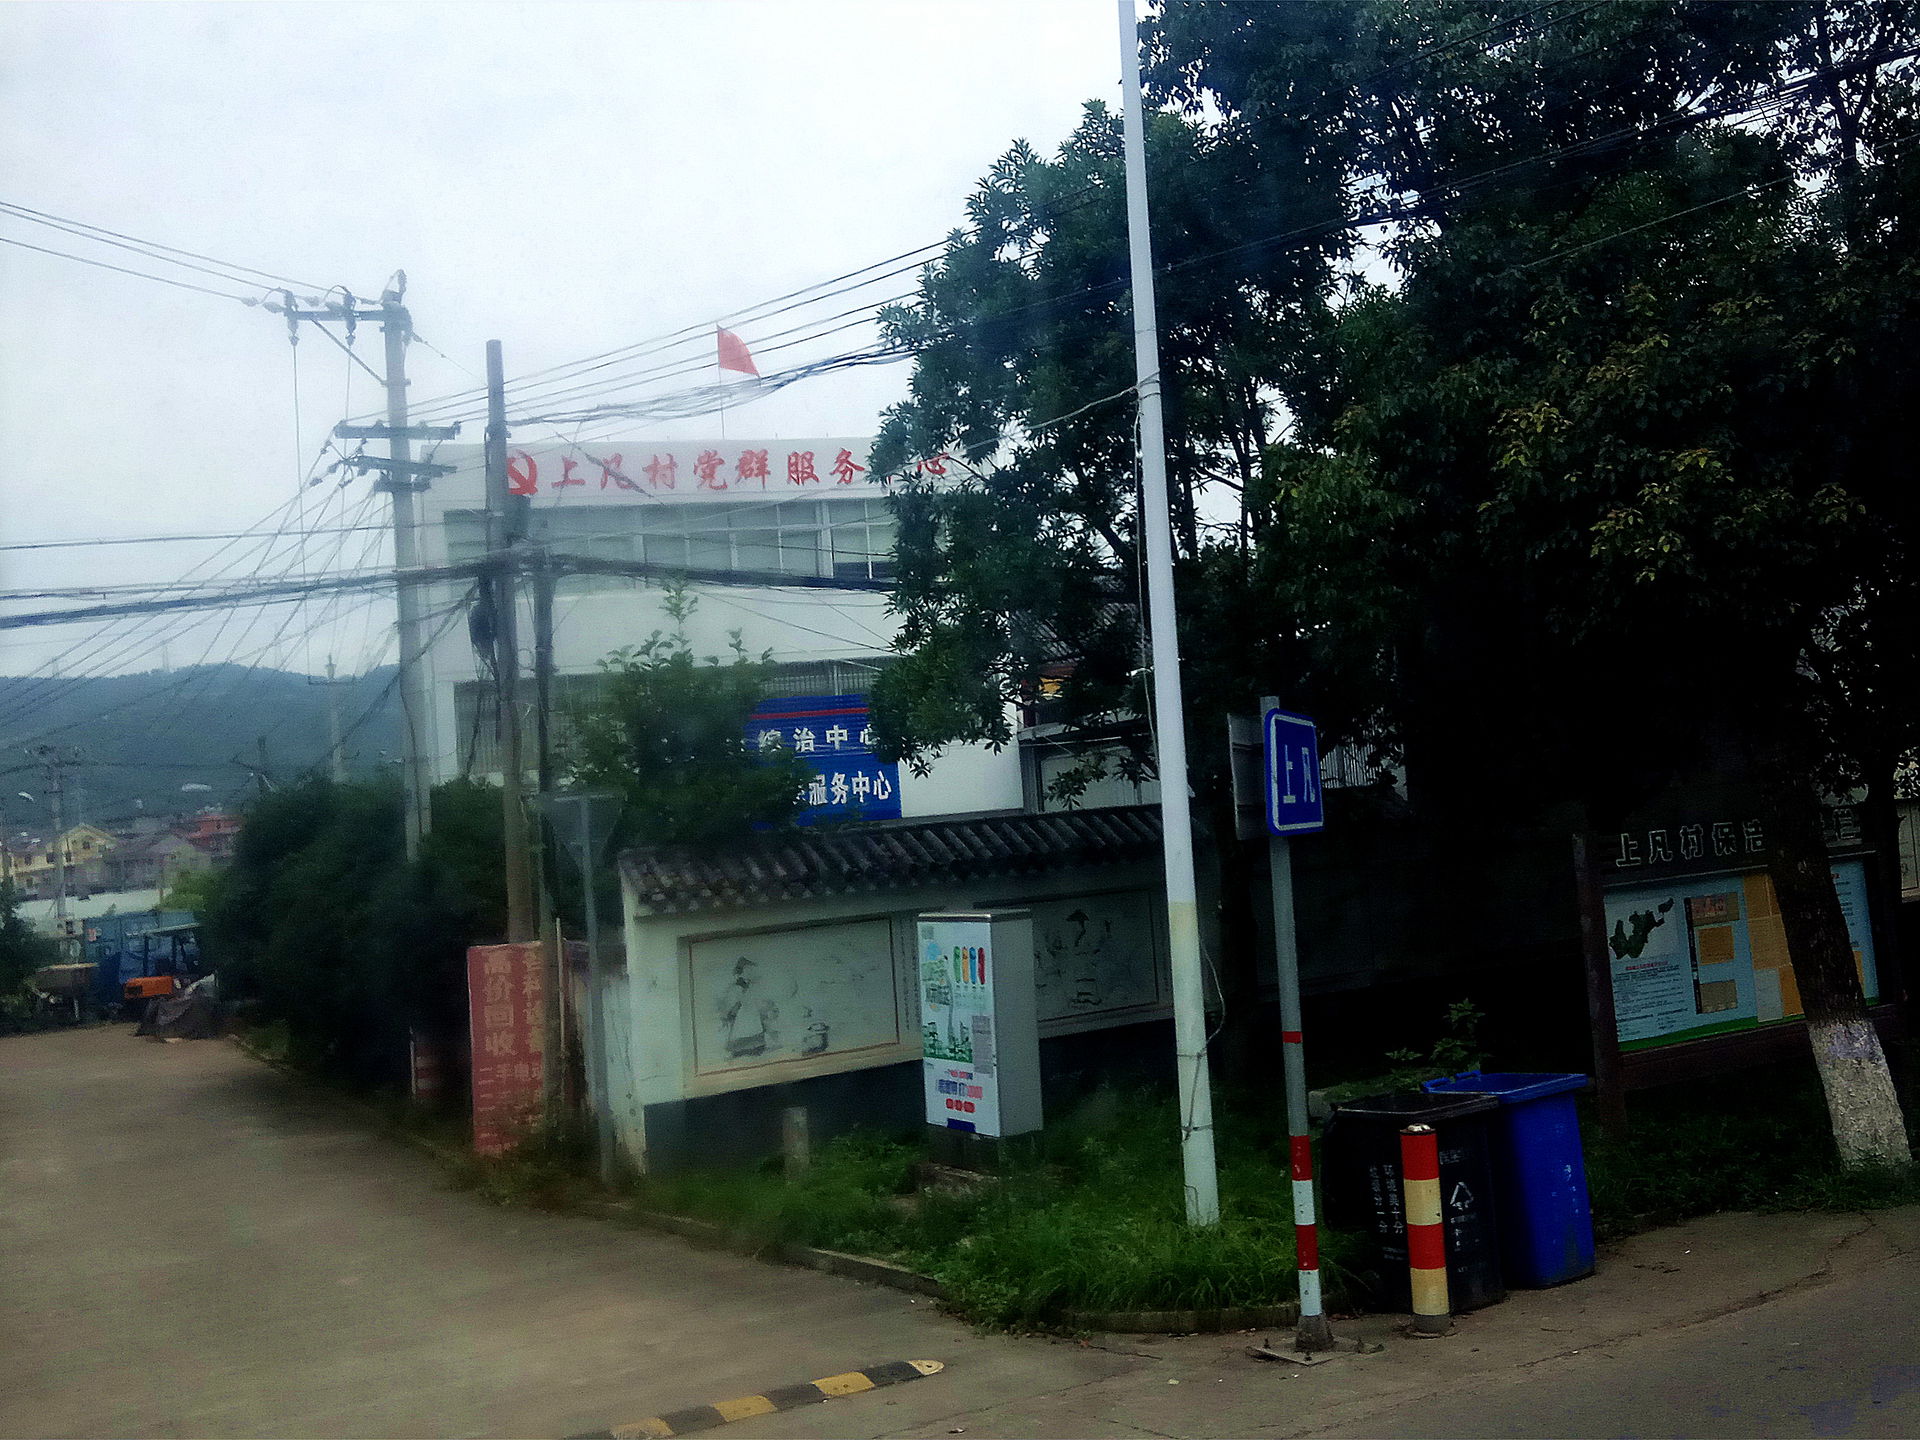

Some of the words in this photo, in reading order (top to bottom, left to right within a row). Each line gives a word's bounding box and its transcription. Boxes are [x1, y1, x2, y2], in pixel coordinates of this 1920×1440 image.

[551, 448, 950, 490] 上凡村党群服务心
[793, 770, 892, 806] 服务中心
[1283, 744, 1316, 804] 上凡
